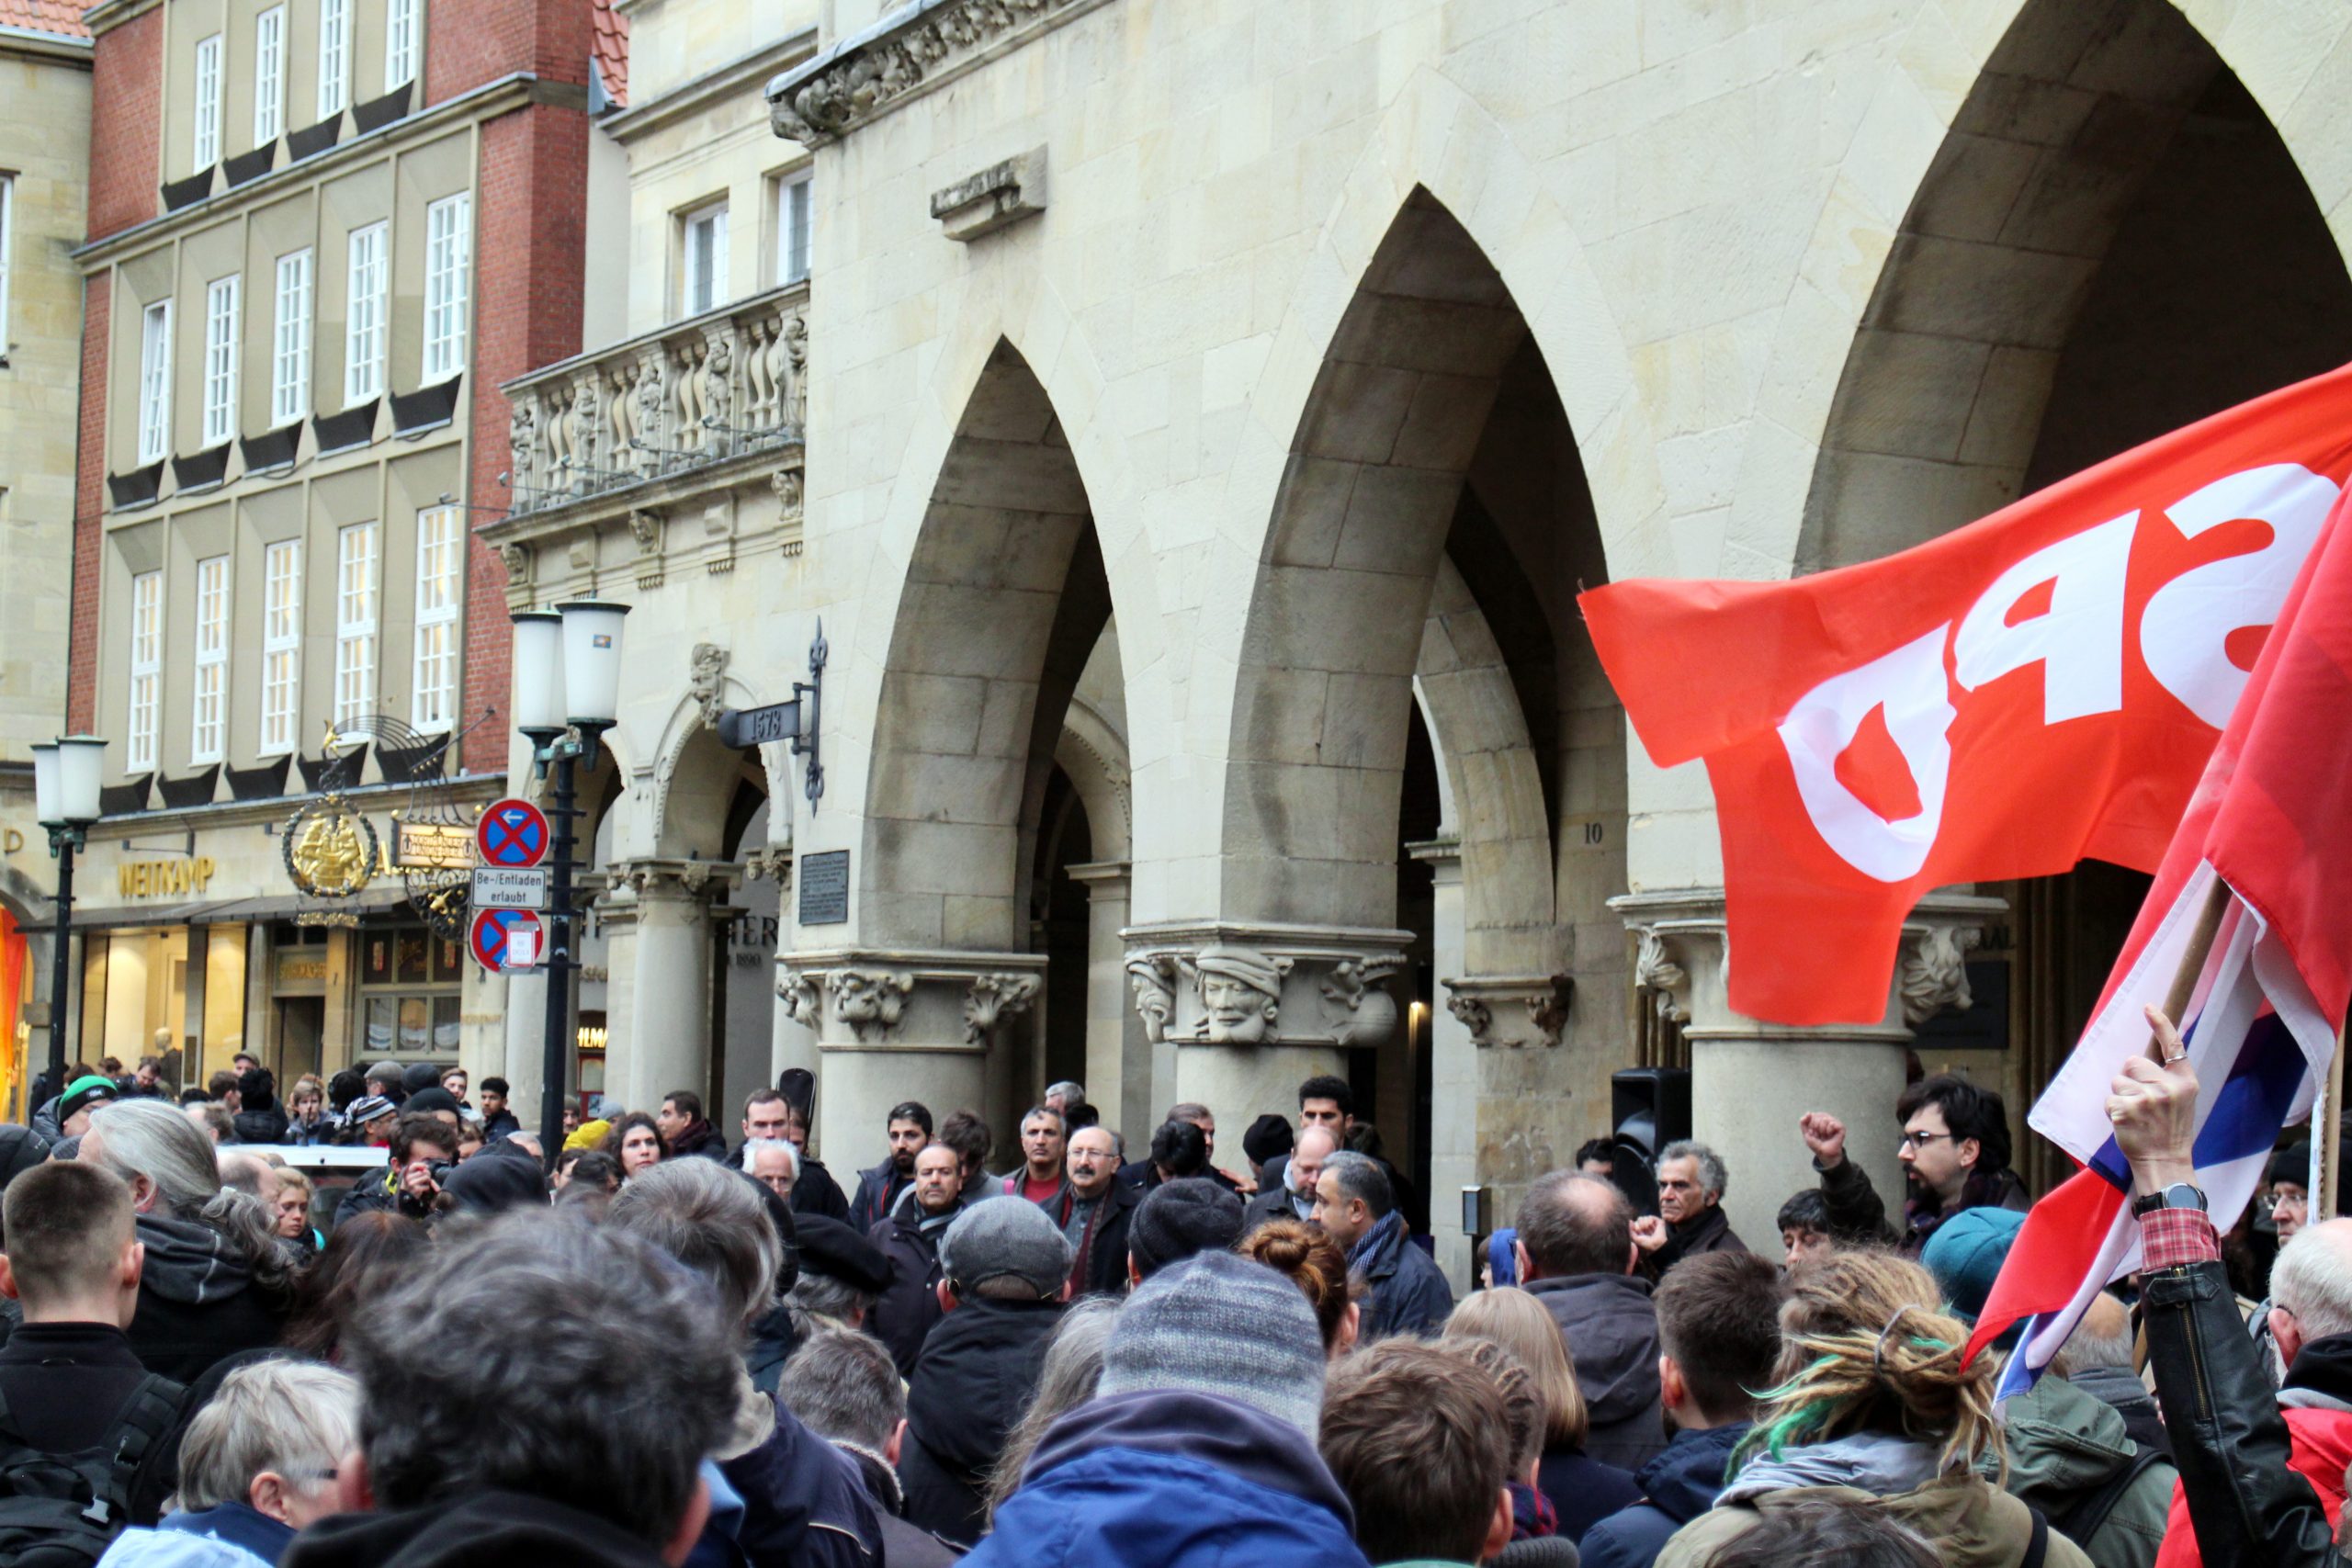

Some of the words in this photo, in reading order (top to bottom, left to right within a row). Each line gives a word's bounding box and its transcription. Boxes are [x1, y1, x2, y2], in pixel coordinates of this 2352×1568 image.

[752, 708, 781, 739] 1578
[1585, 822, 1603, 844] 10
[117, 856, 216, 897] WEITKAMP
[476, 873, 542, 887] Be-/Entladen
[491, 891, 526, 903] erlaubt
